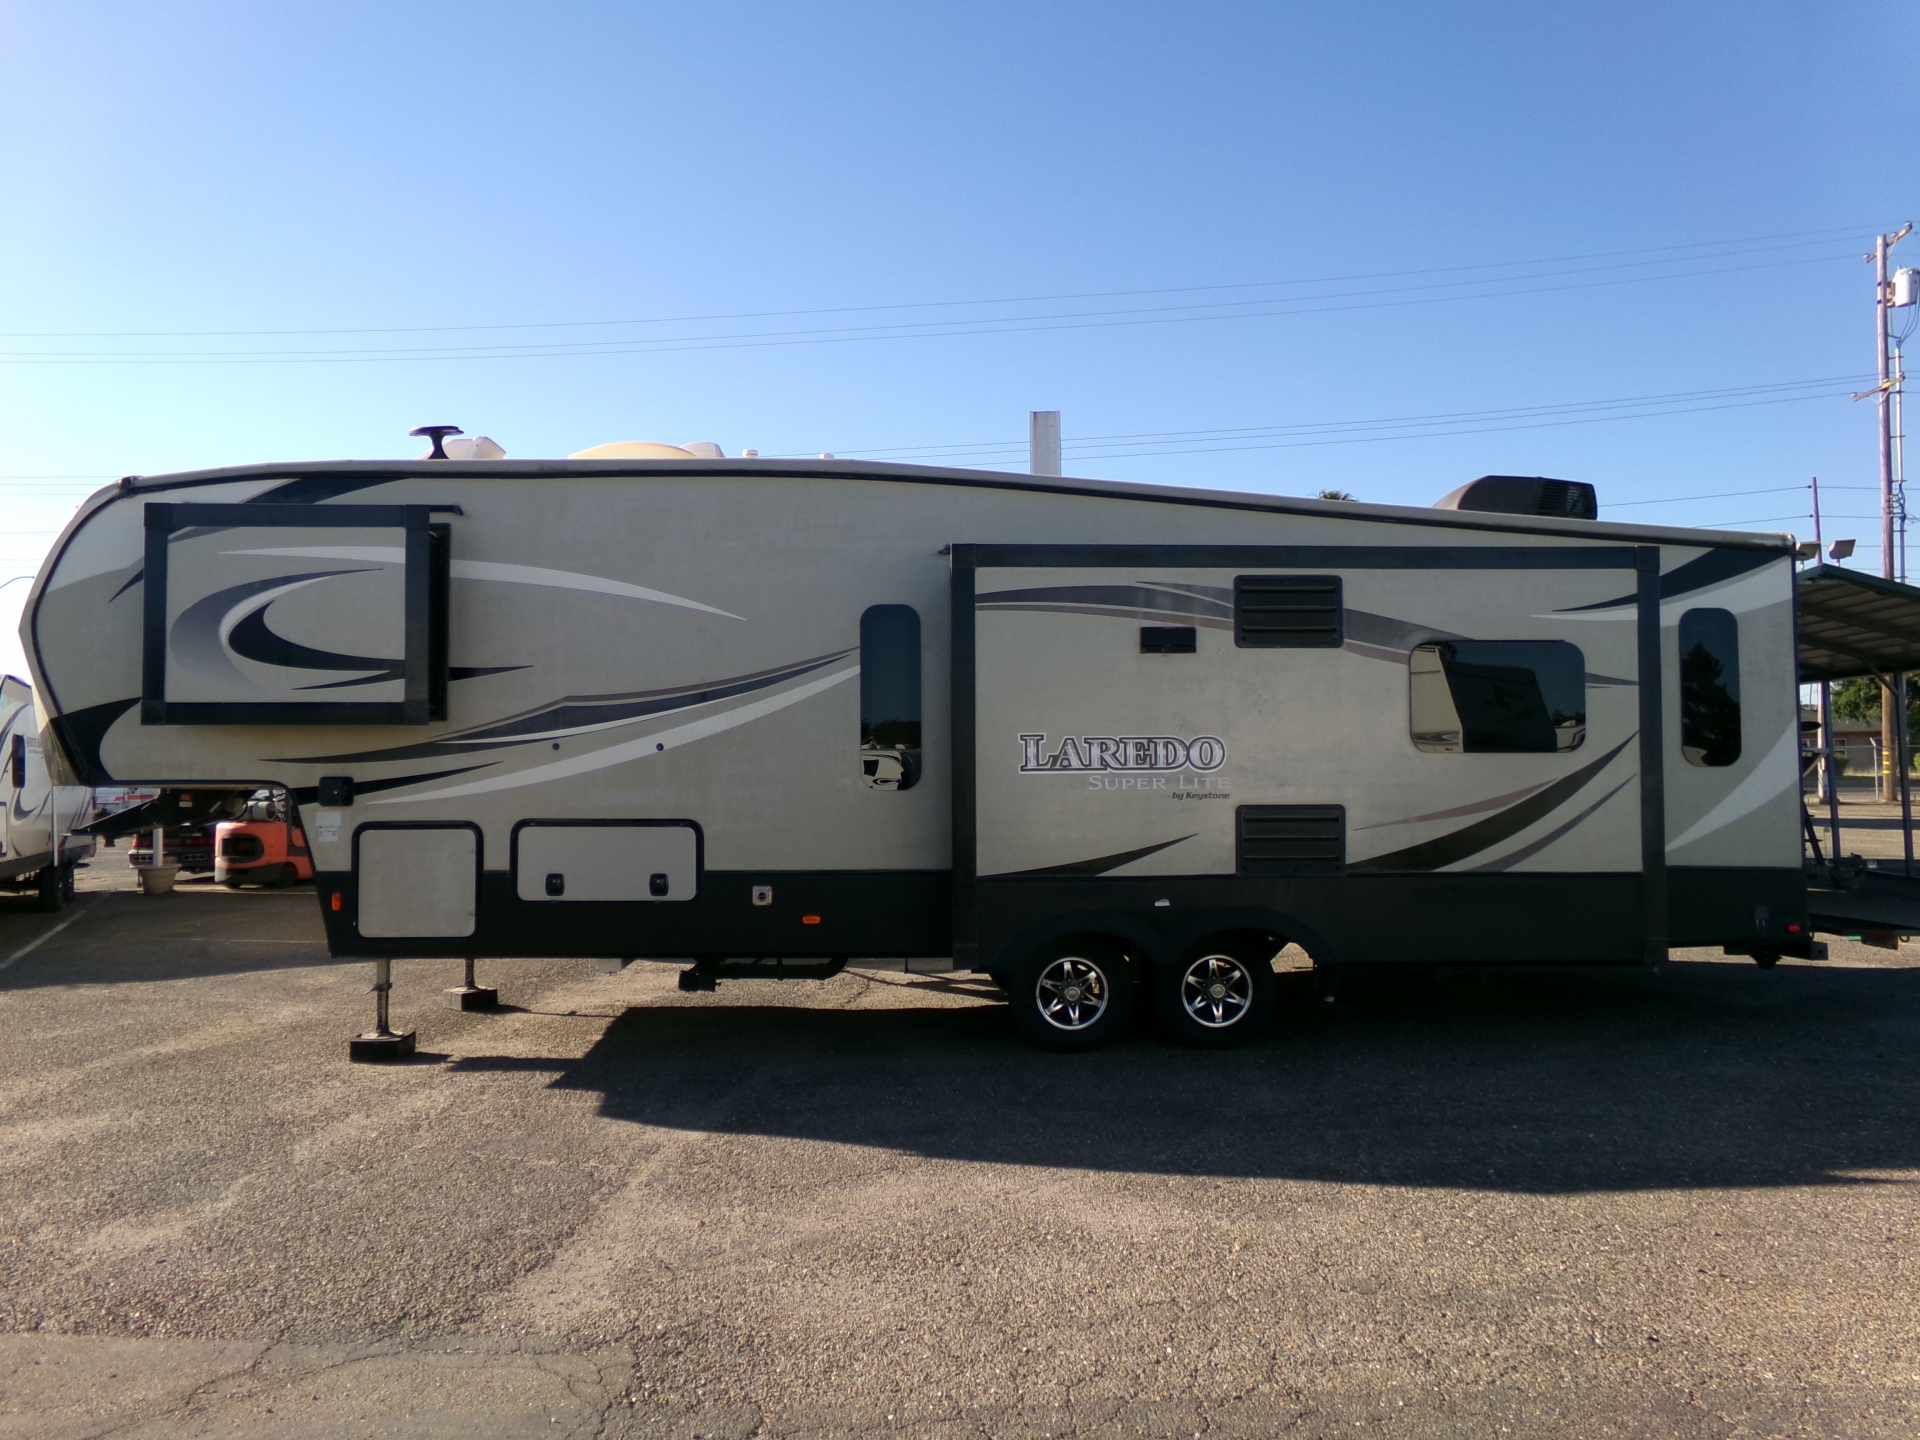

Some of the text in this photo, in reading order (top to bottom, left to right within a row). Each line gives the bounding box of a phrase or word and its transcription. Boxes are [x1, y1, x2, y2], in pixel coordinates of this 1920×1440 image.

[1018, 733, 1226, 774] LAREDO
[1088, 775, 1230, 790] SUPER LITE
[1172, 792, 1230, 800] by Keystone
